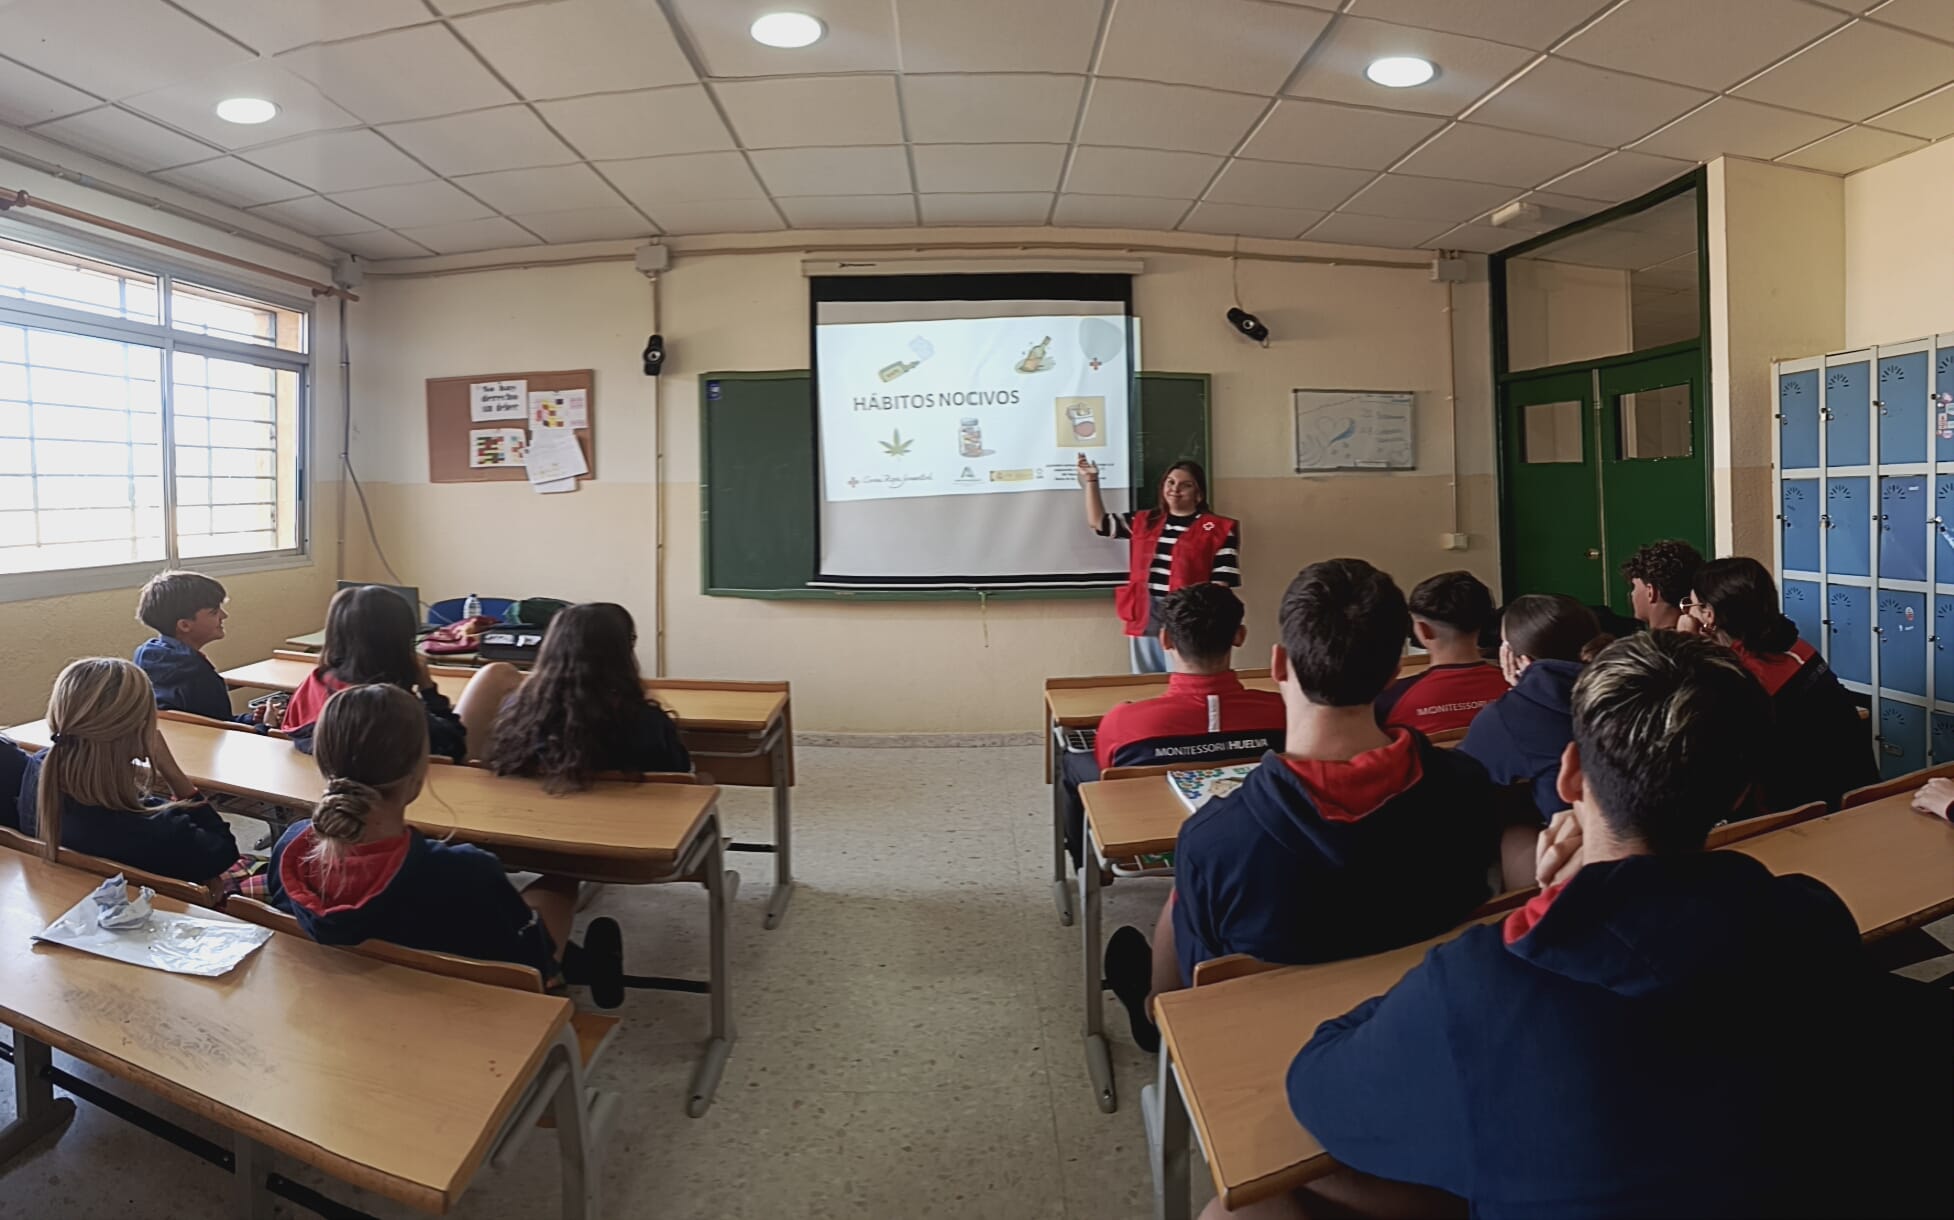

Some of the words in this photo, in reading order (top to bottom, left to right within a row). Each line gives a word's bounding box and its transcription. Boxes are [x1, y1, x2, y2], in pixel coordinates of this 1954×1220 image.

[853, 393, 935, 411] HÁBITOS
[939, 390, 1020, 406] NOCIVOS
[1155, 743, 1226, 757] MONTESSORI
[1228, 739, 1268, 750] HUELVA
